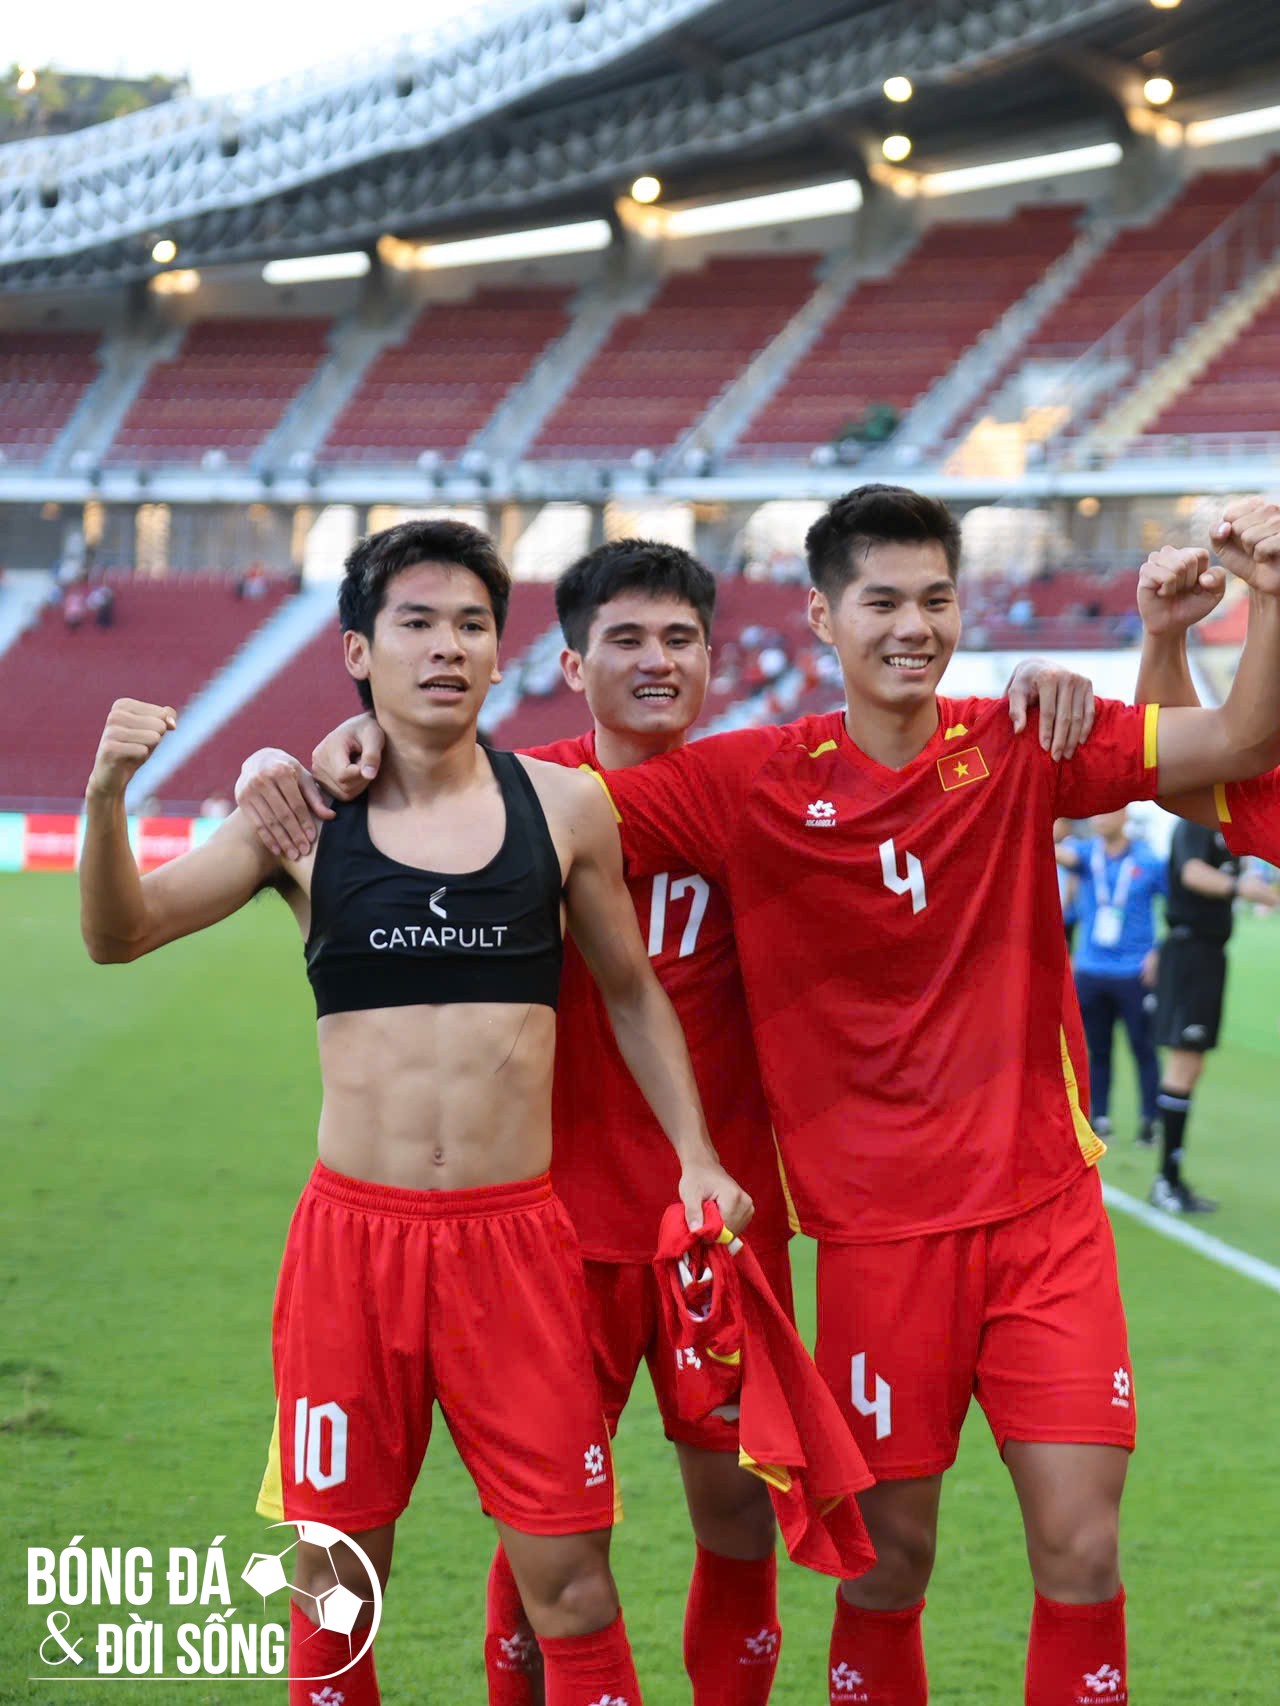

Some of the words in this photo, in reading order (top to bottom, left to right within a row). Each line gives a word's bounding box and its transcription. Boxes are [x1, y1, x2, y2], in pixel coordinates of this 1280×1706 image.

[647, 871, 711, 959] 17
[877, 837, 927, 915] 4
[369, 925, 508, 950] CATAPULT
[849, 1351, 892, 1440] 4
[293, 1396, 349, 1492] 10
